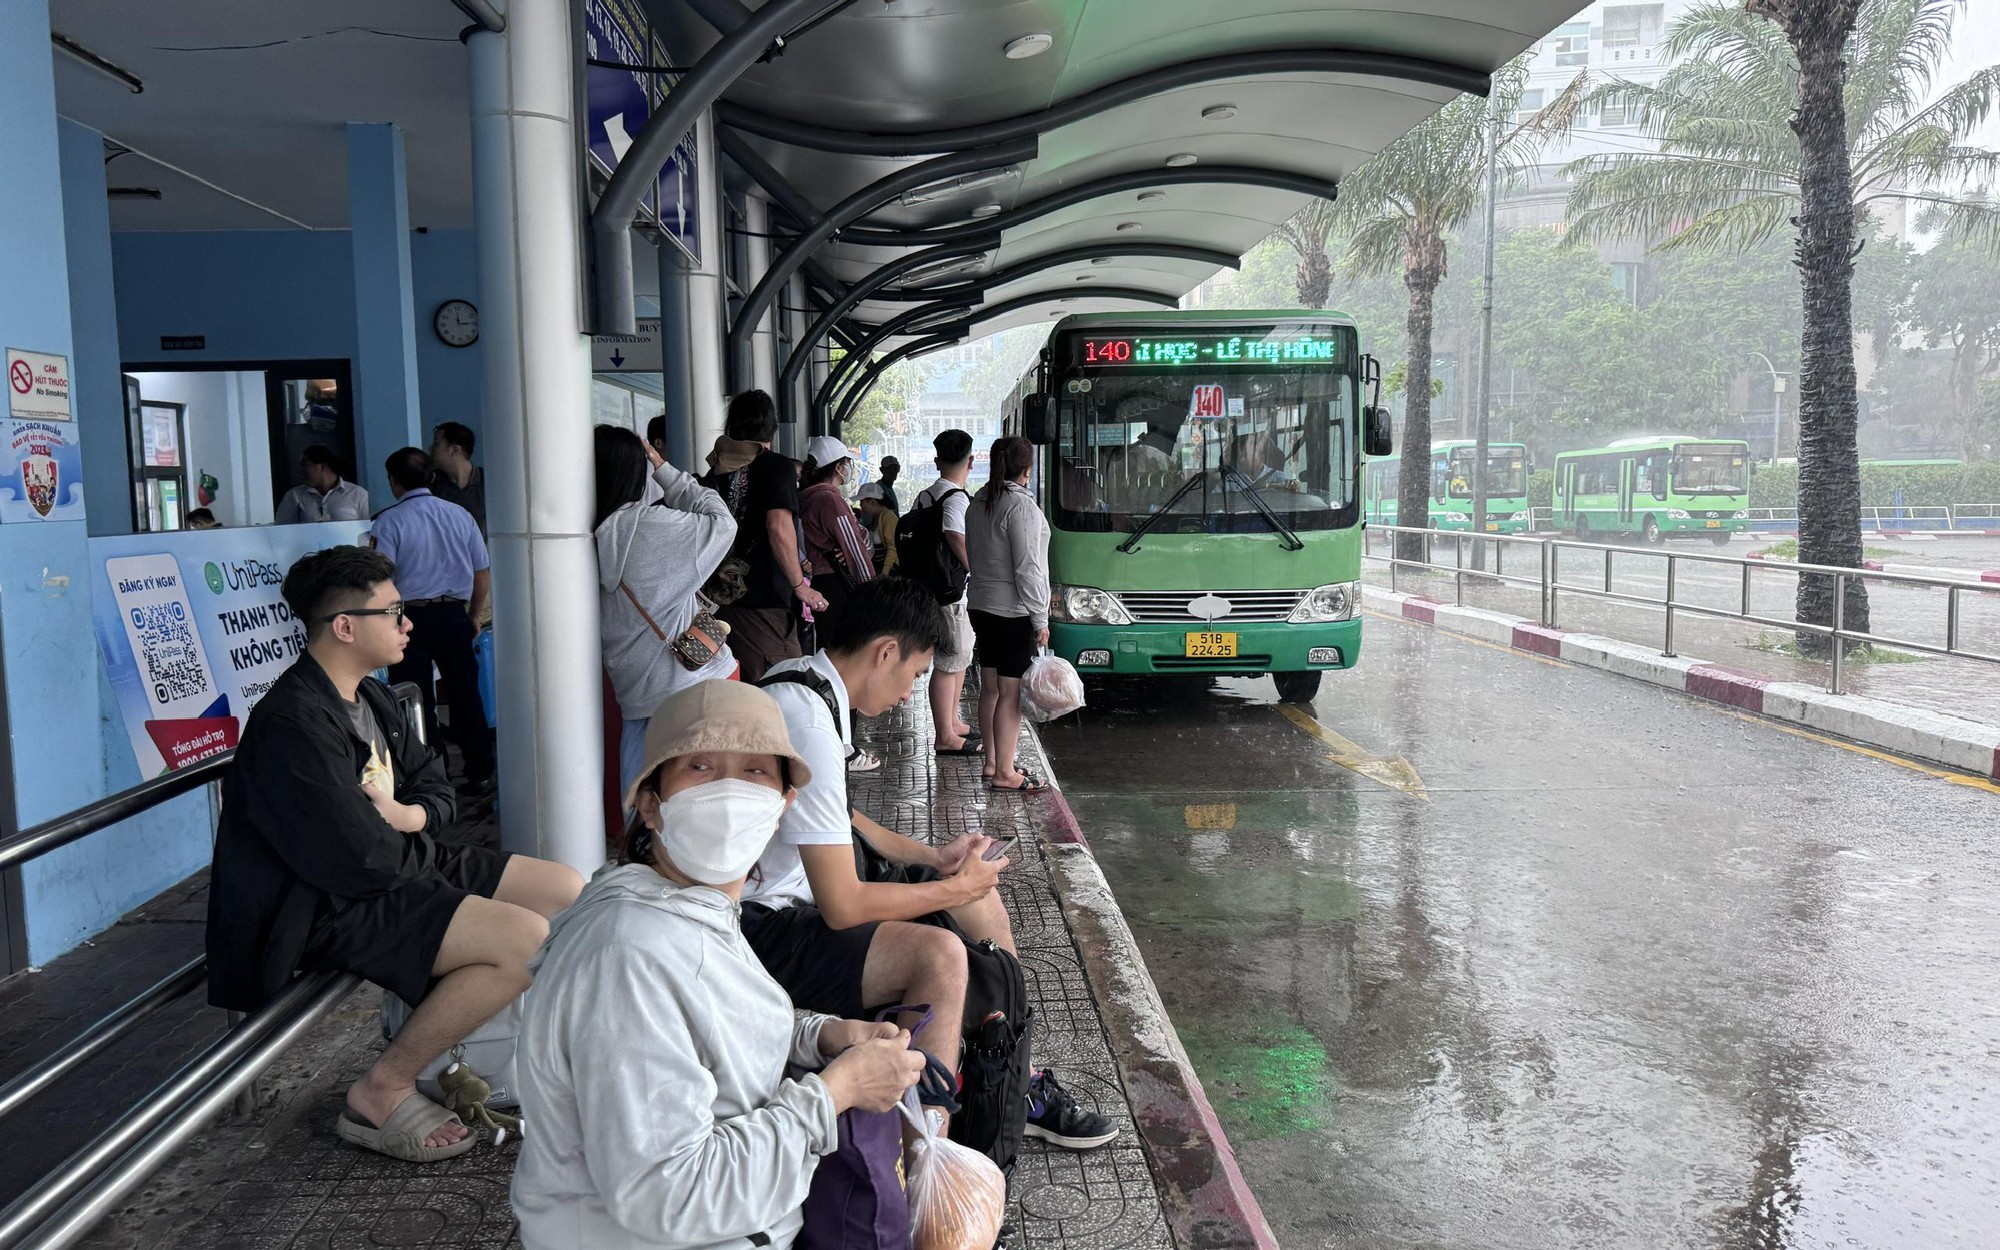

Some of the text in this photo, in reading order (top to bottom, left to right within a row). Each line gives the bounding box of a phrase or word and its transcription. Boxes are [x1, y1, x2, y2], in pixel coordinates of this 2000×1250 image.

[1086, 341, 1130, 361] 140
[46, 388, 68, 399] Smoking
[1195, 386, 1223, 416] 140
[30, 444, 46, 455] 2023
[222, 559, 282, 591] UniPass
[119, 576, 176, 593] ĐĂNG KÝ NGAY
[218, 606, 270, 635] THANH
[1200, 634, 1222, 644] 51B
[158, 644, 182, 659] UniPass
[230, 638, 283, 671] KHÔNG
[1192, 645, 1231, 656] 224.25
[241, 682, 270, 698] UniPass
